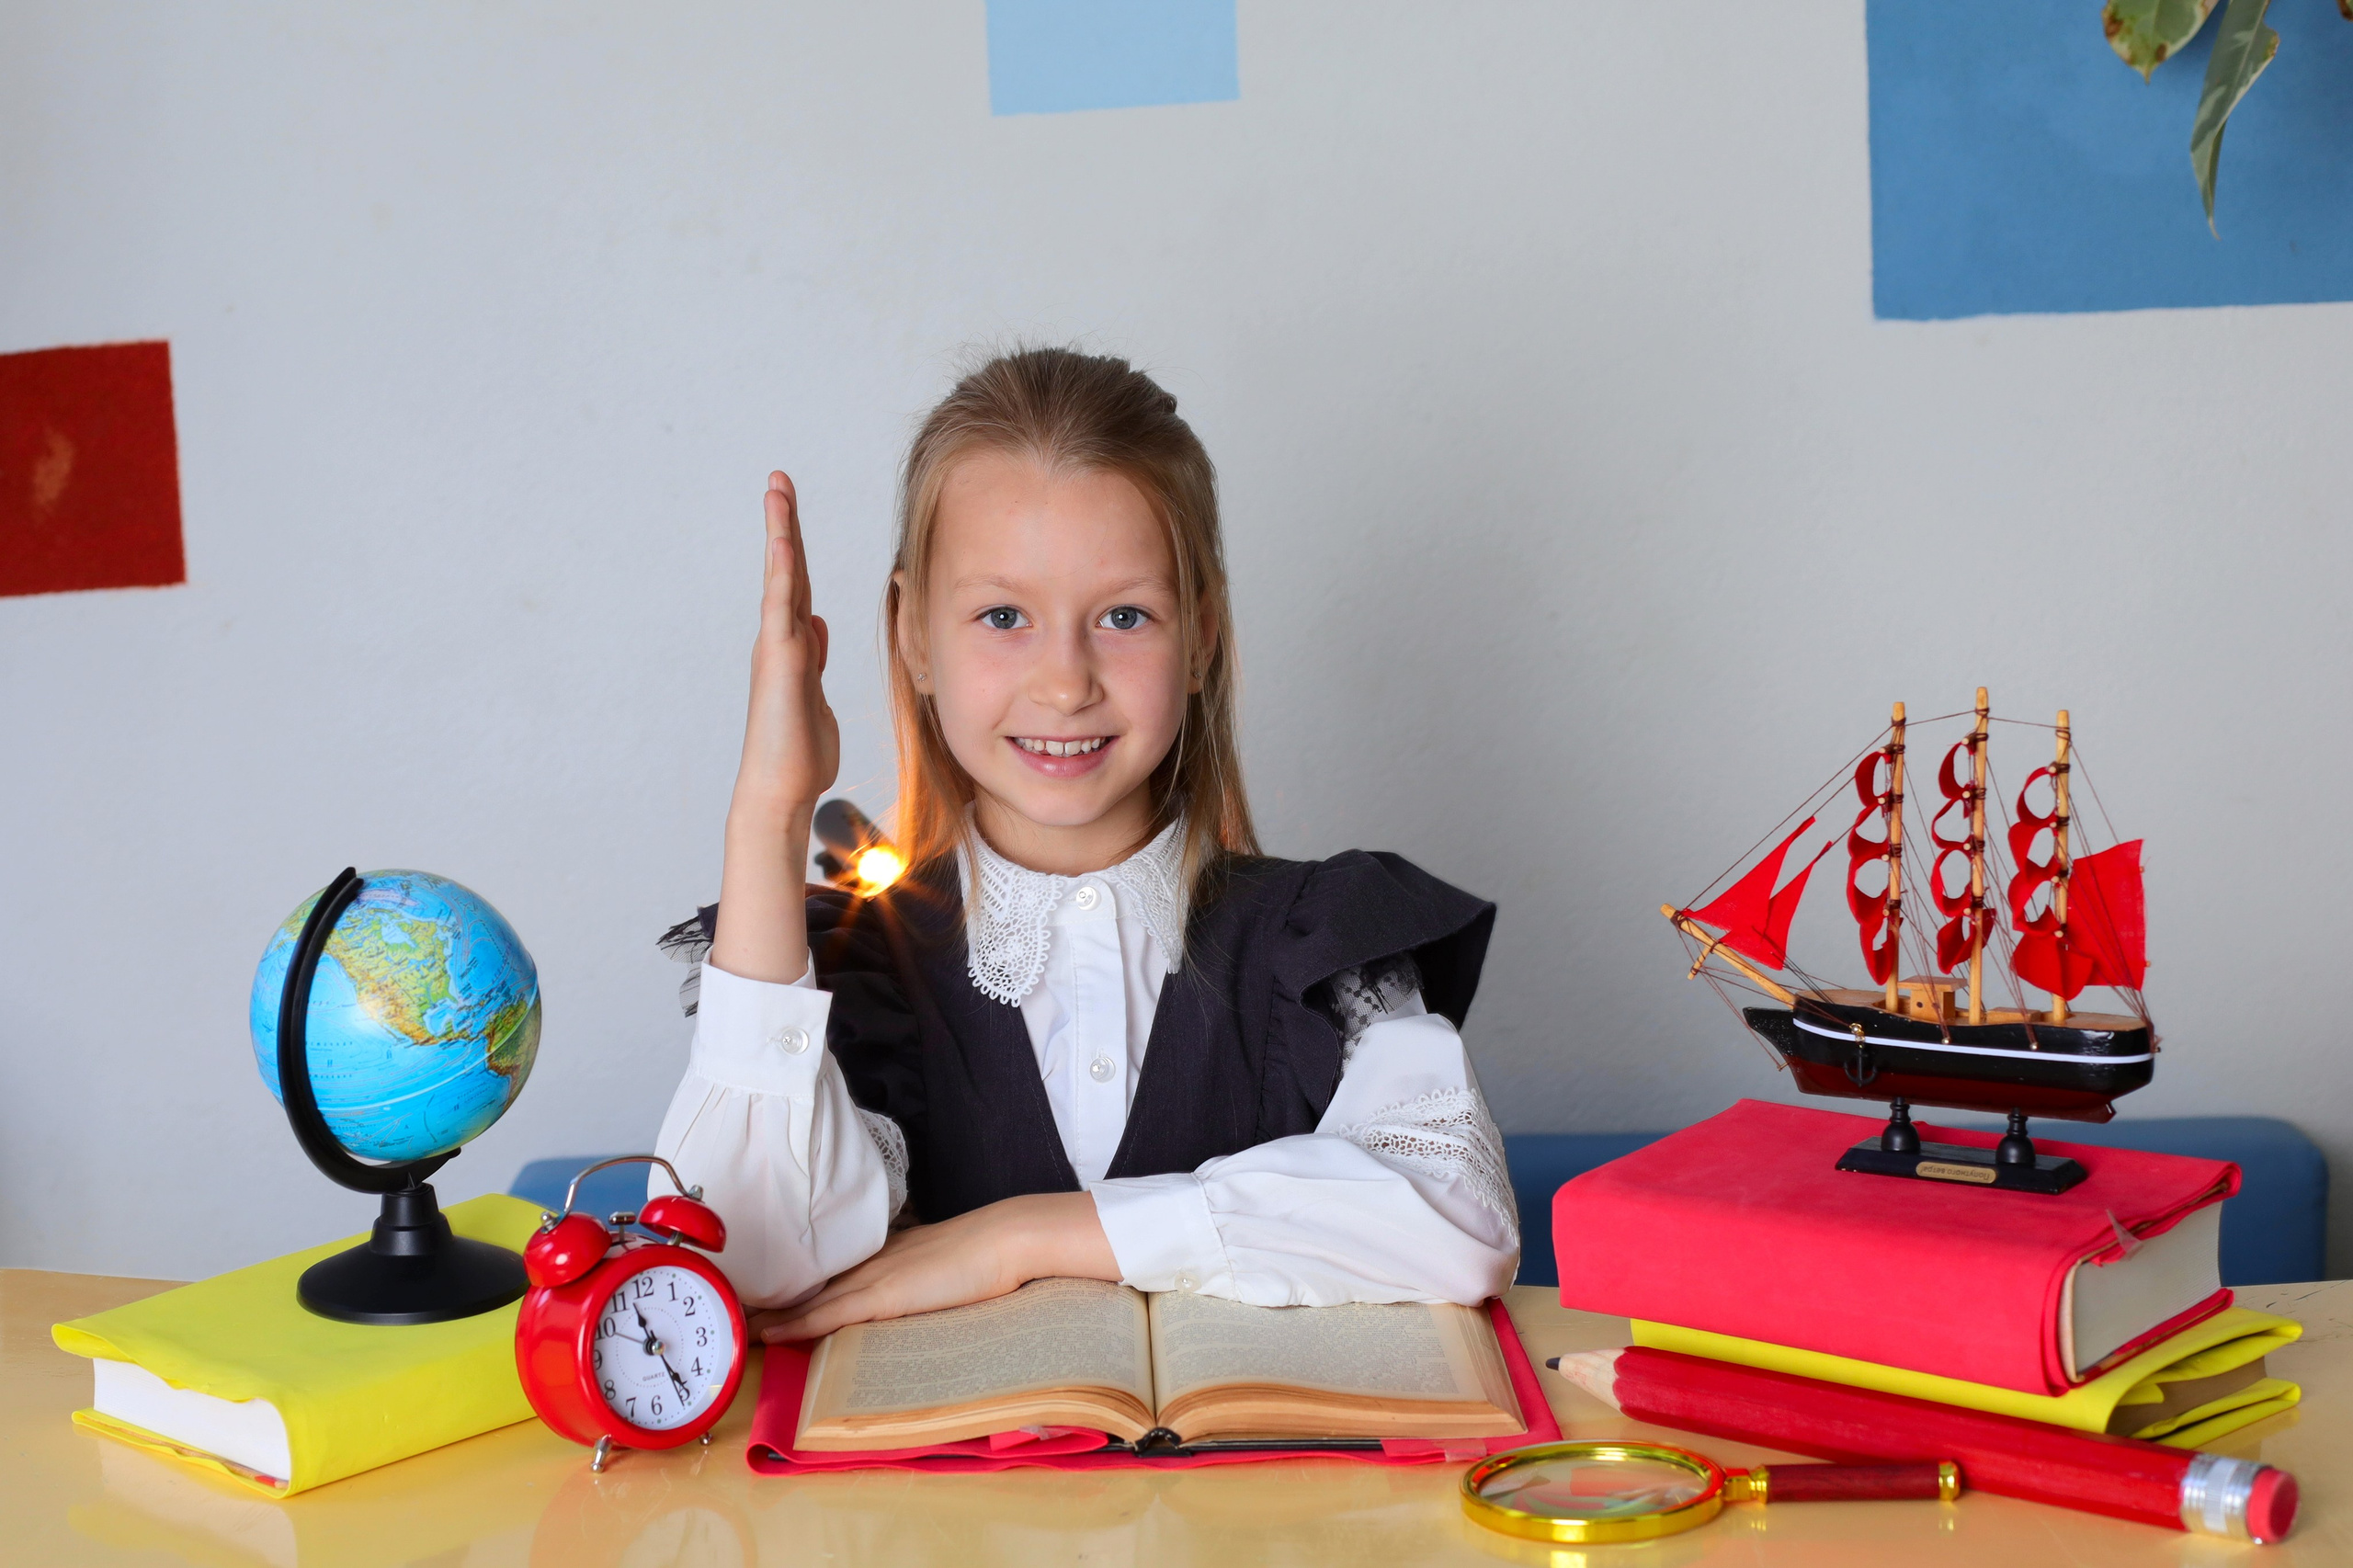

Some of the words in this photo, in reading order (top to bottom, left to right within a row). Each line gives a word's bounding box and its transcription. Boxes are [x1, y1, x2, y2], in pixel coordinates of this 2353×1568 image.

[1947, 1168, 1990, 1181] Попутного
[631, 1277, 654, 1300] 12
[667, 1281, 678, 1302] 1
[610, 1291, 630, 1314] 11
[683, 1296, 696, 1317] 2
[596, 1317, 616, 1341] 10
[696, 1326, 708, 1347] 3
[594, 1349, 603, 1370] 9
[691, 1357, 704, 1377] 4
[642, 1371, 665, 1382] QUARTZ
[604, 1380, 616, 1401] 8
[678, 1380, 690, 1402] 5
[625, 1397, 637, 1418] 7
[651, 1395, 663, 1415] 6
